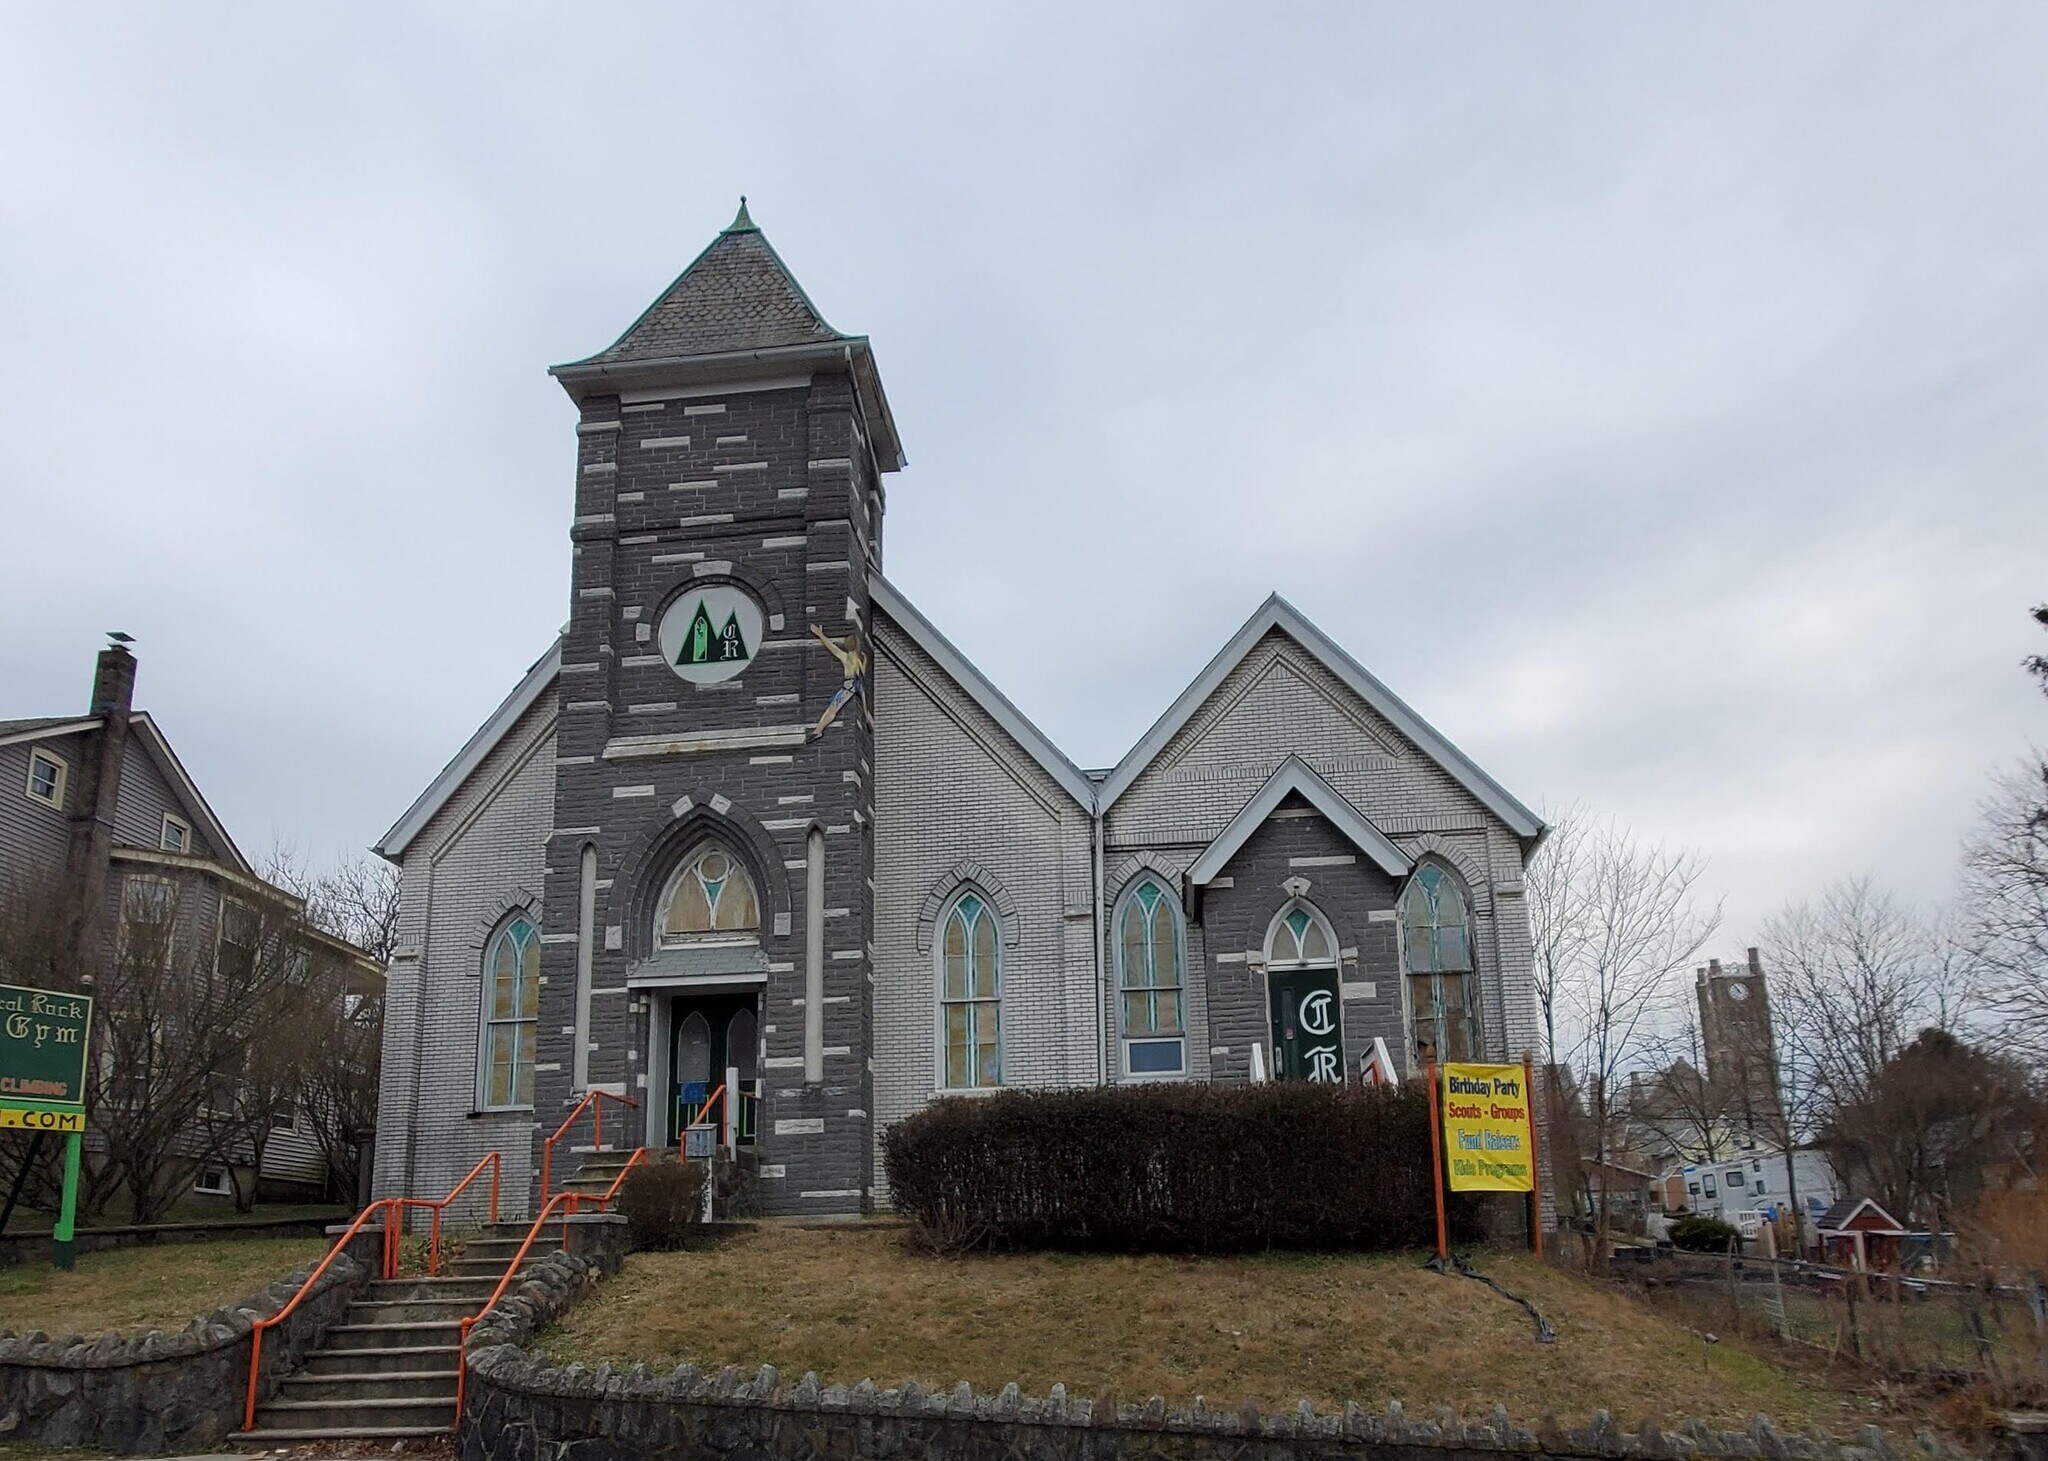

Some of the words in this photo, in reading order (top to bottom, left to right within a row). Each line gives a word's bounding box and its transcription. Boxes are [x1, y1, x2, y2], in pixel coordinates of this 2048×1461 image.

[30, 993, 83, 1019] Rock
[6, 1012, 79, 1049] Gym
[1449, 1076, 1491, 1098] Birthday
[1493, 1078, 1520, 1099] Party
[0, 1110, 78, 1130] .COM
[1448, 1102, 1482, 1119] Scouts
[1490, 1103, 1526, 1122] Groups
[1457, 1128, 1483, 1150] Fund
[1485, 1129, 1521, 1151] Raisers
[1478, 1159, 1528, 1179] Programs
